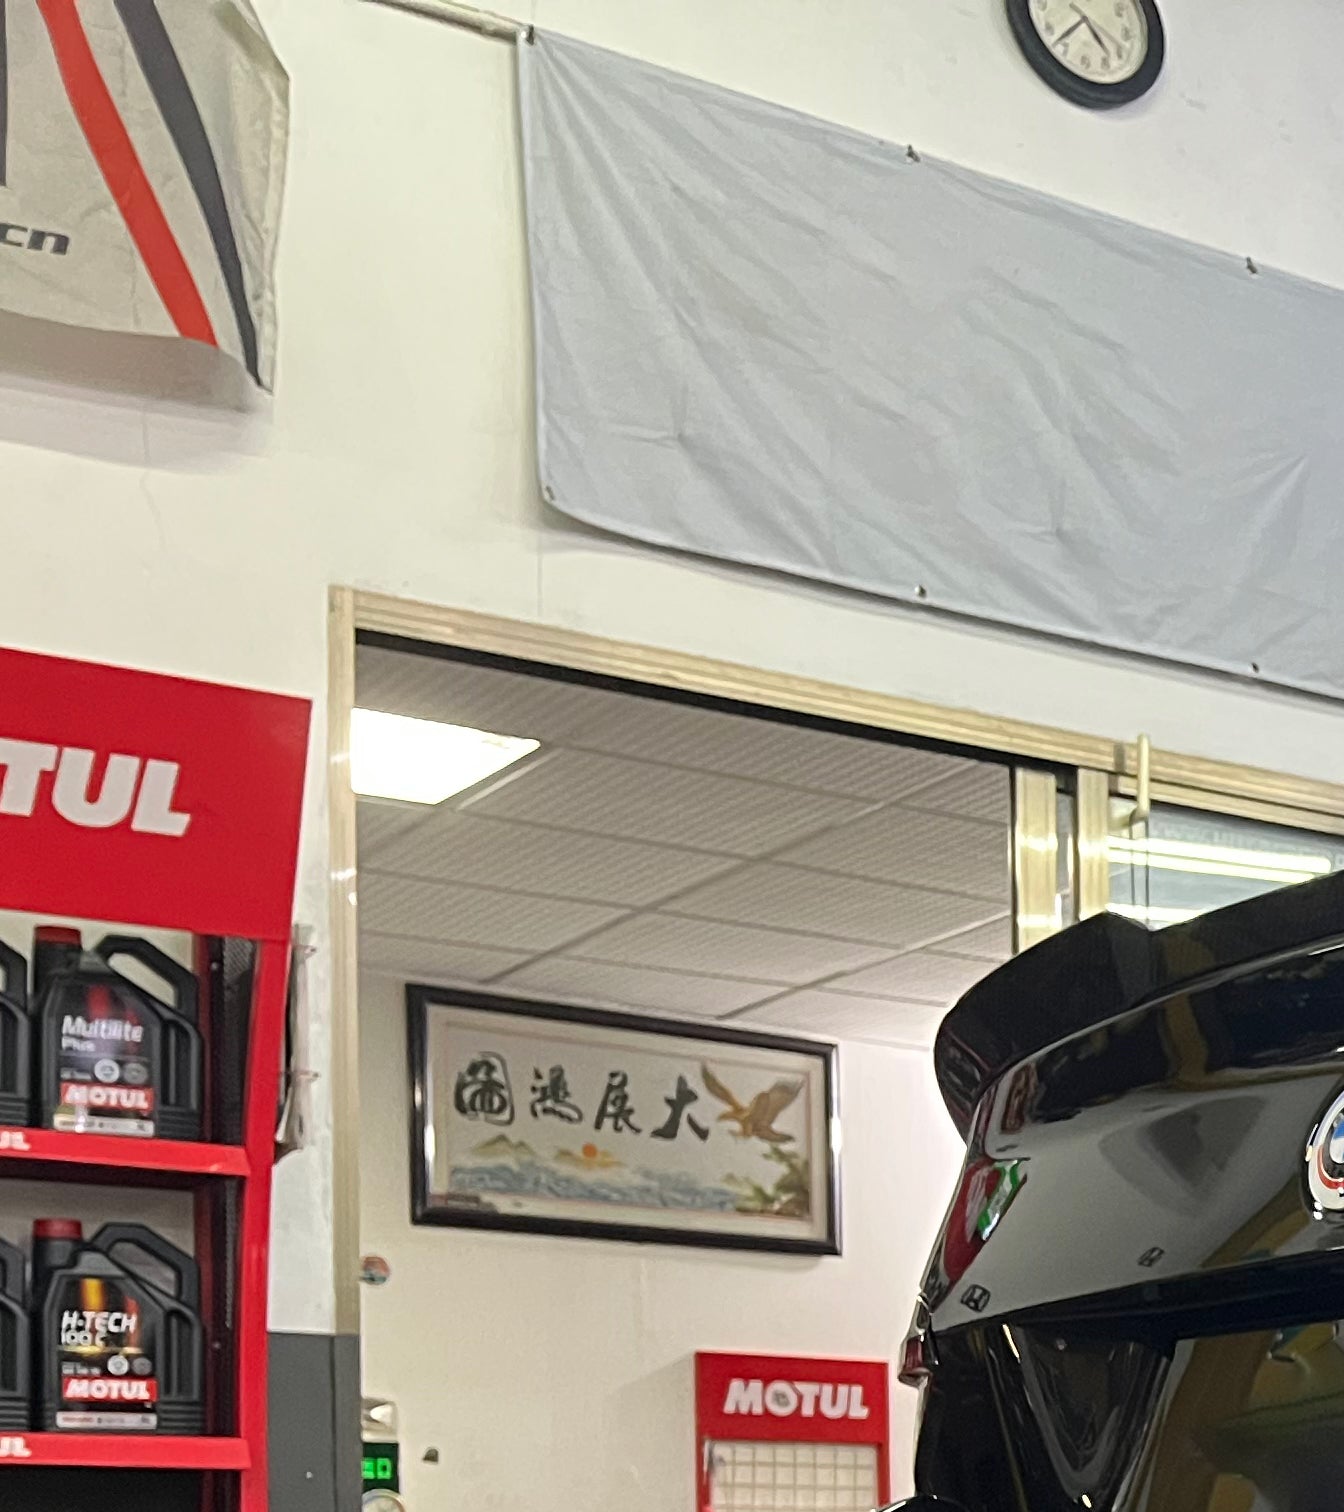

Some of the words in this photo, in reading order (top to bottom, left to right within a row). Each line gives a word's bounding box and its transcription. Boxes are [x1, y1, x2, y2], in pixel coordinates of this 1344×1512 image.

[65, 1084, 149, 1110] MOTUL
[61, 1310, 138, 1334] H-TECH
[65, 1378, 150, 1400] MOTUL
[724, 1378, 871, 1420] MOTUL
